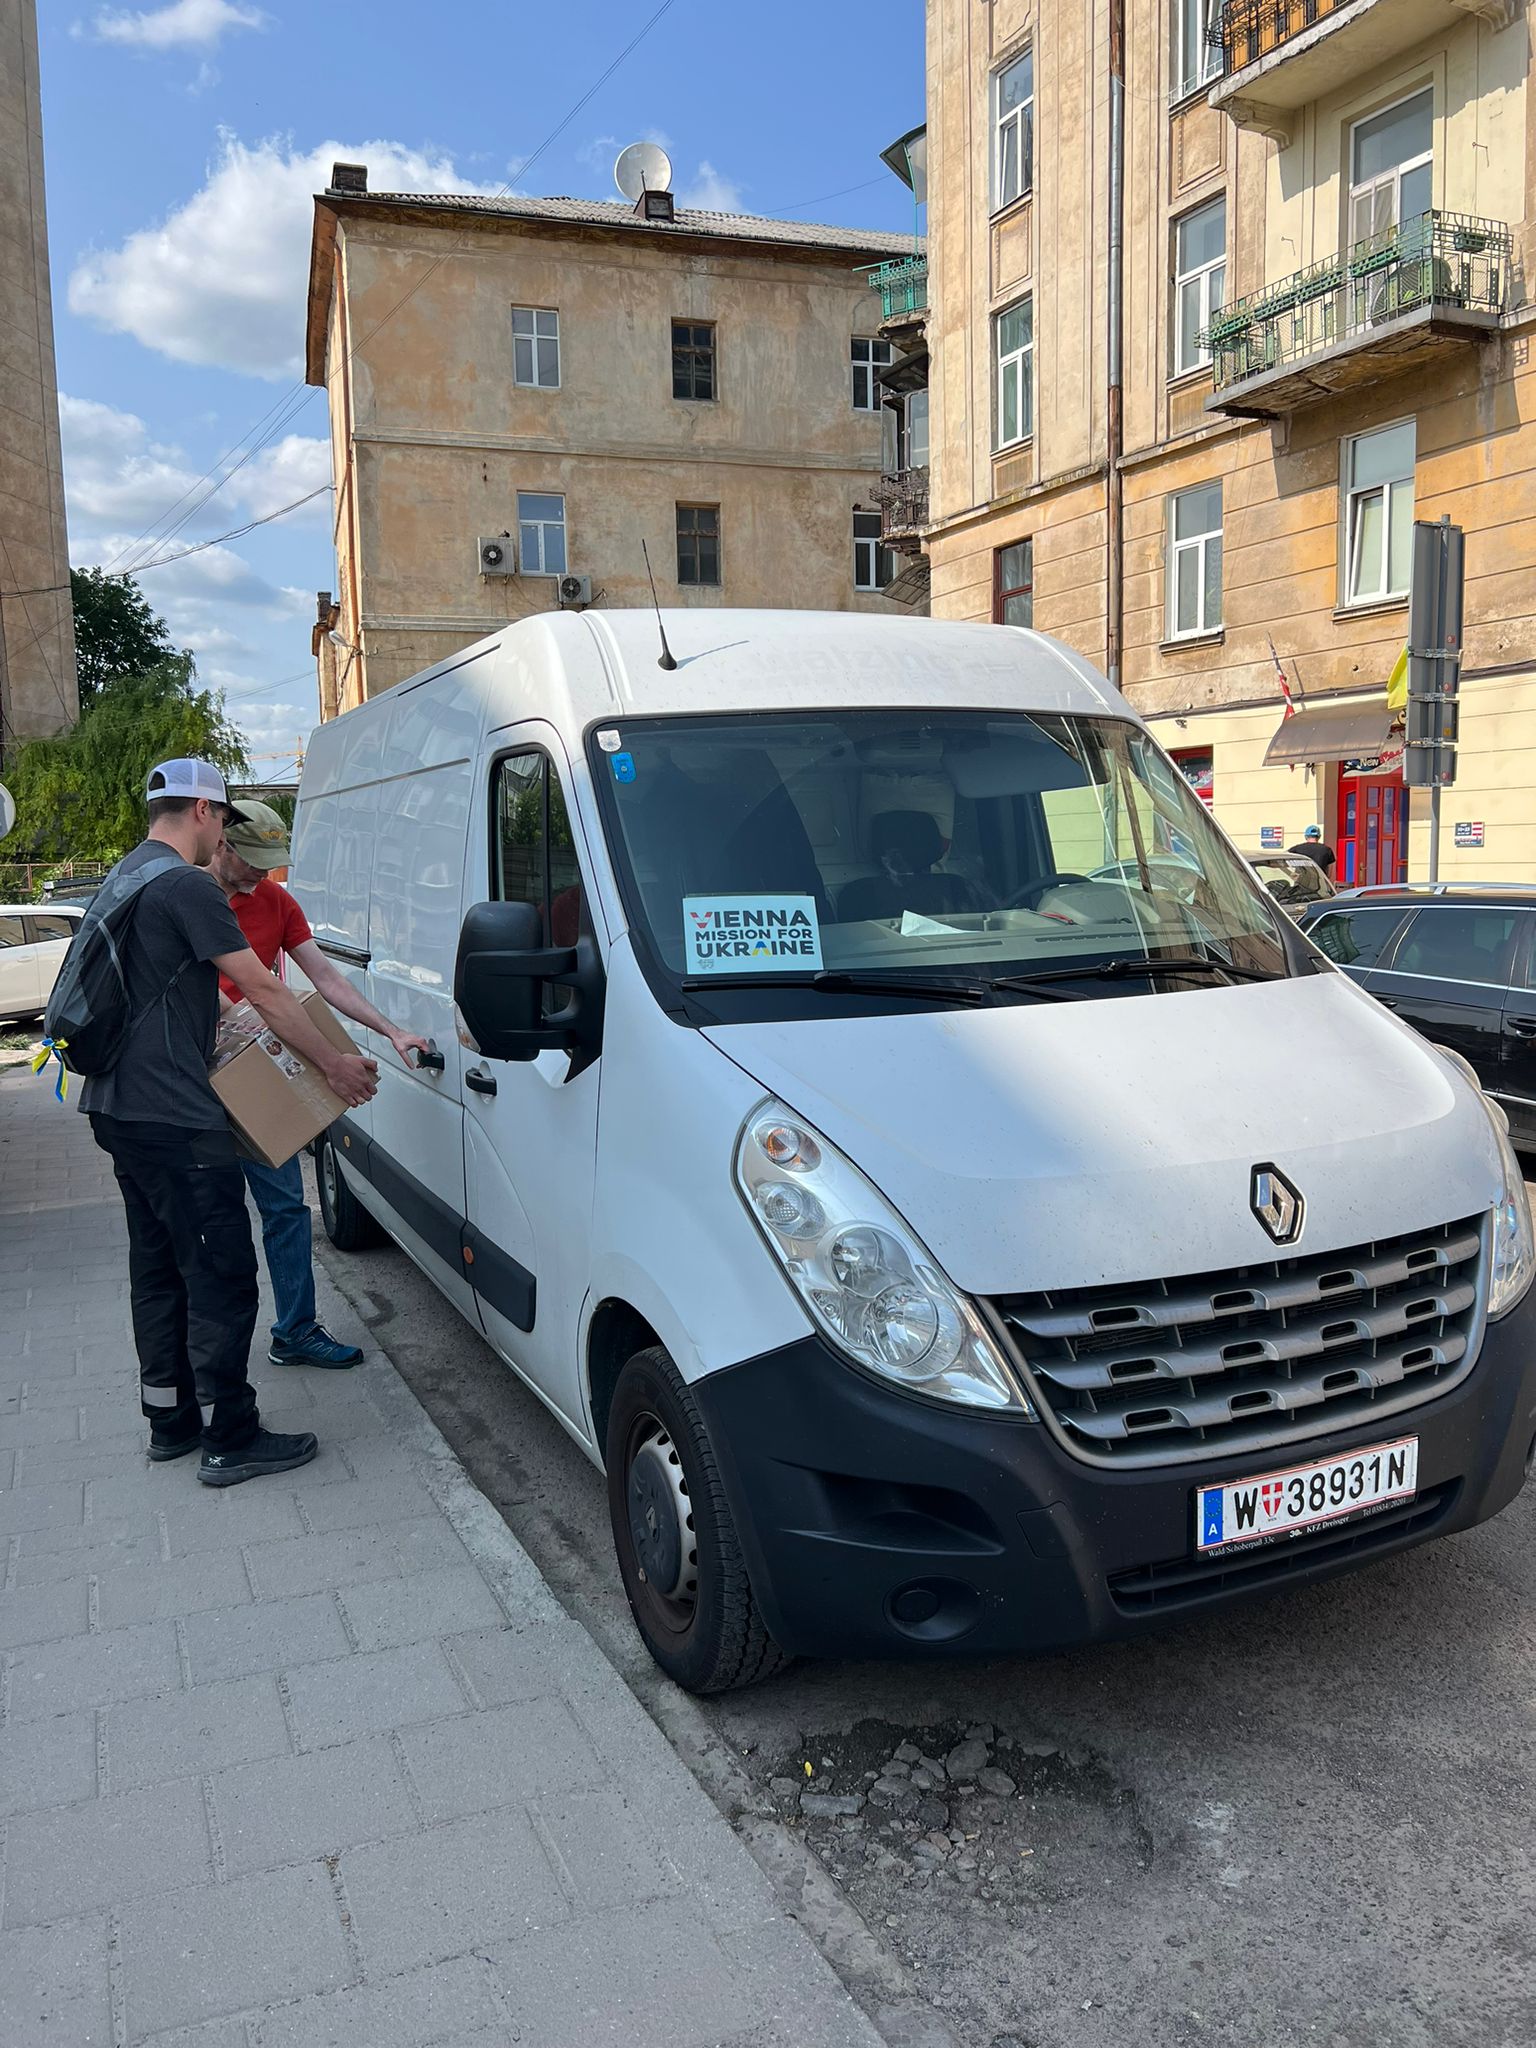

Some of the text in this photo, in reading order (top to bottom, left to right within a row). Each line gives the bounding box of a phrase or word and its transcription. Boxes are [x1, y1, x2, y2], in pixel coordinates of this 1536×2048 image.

[690, 910, 812, 929] VIENNA
[695, 928, 813, 941] MISSION FOR
[696, 940, 815, 958] UKRAINE
[1233, 1487, 1258, 1530] W
[1208, 1523, 1218, 1536] A
